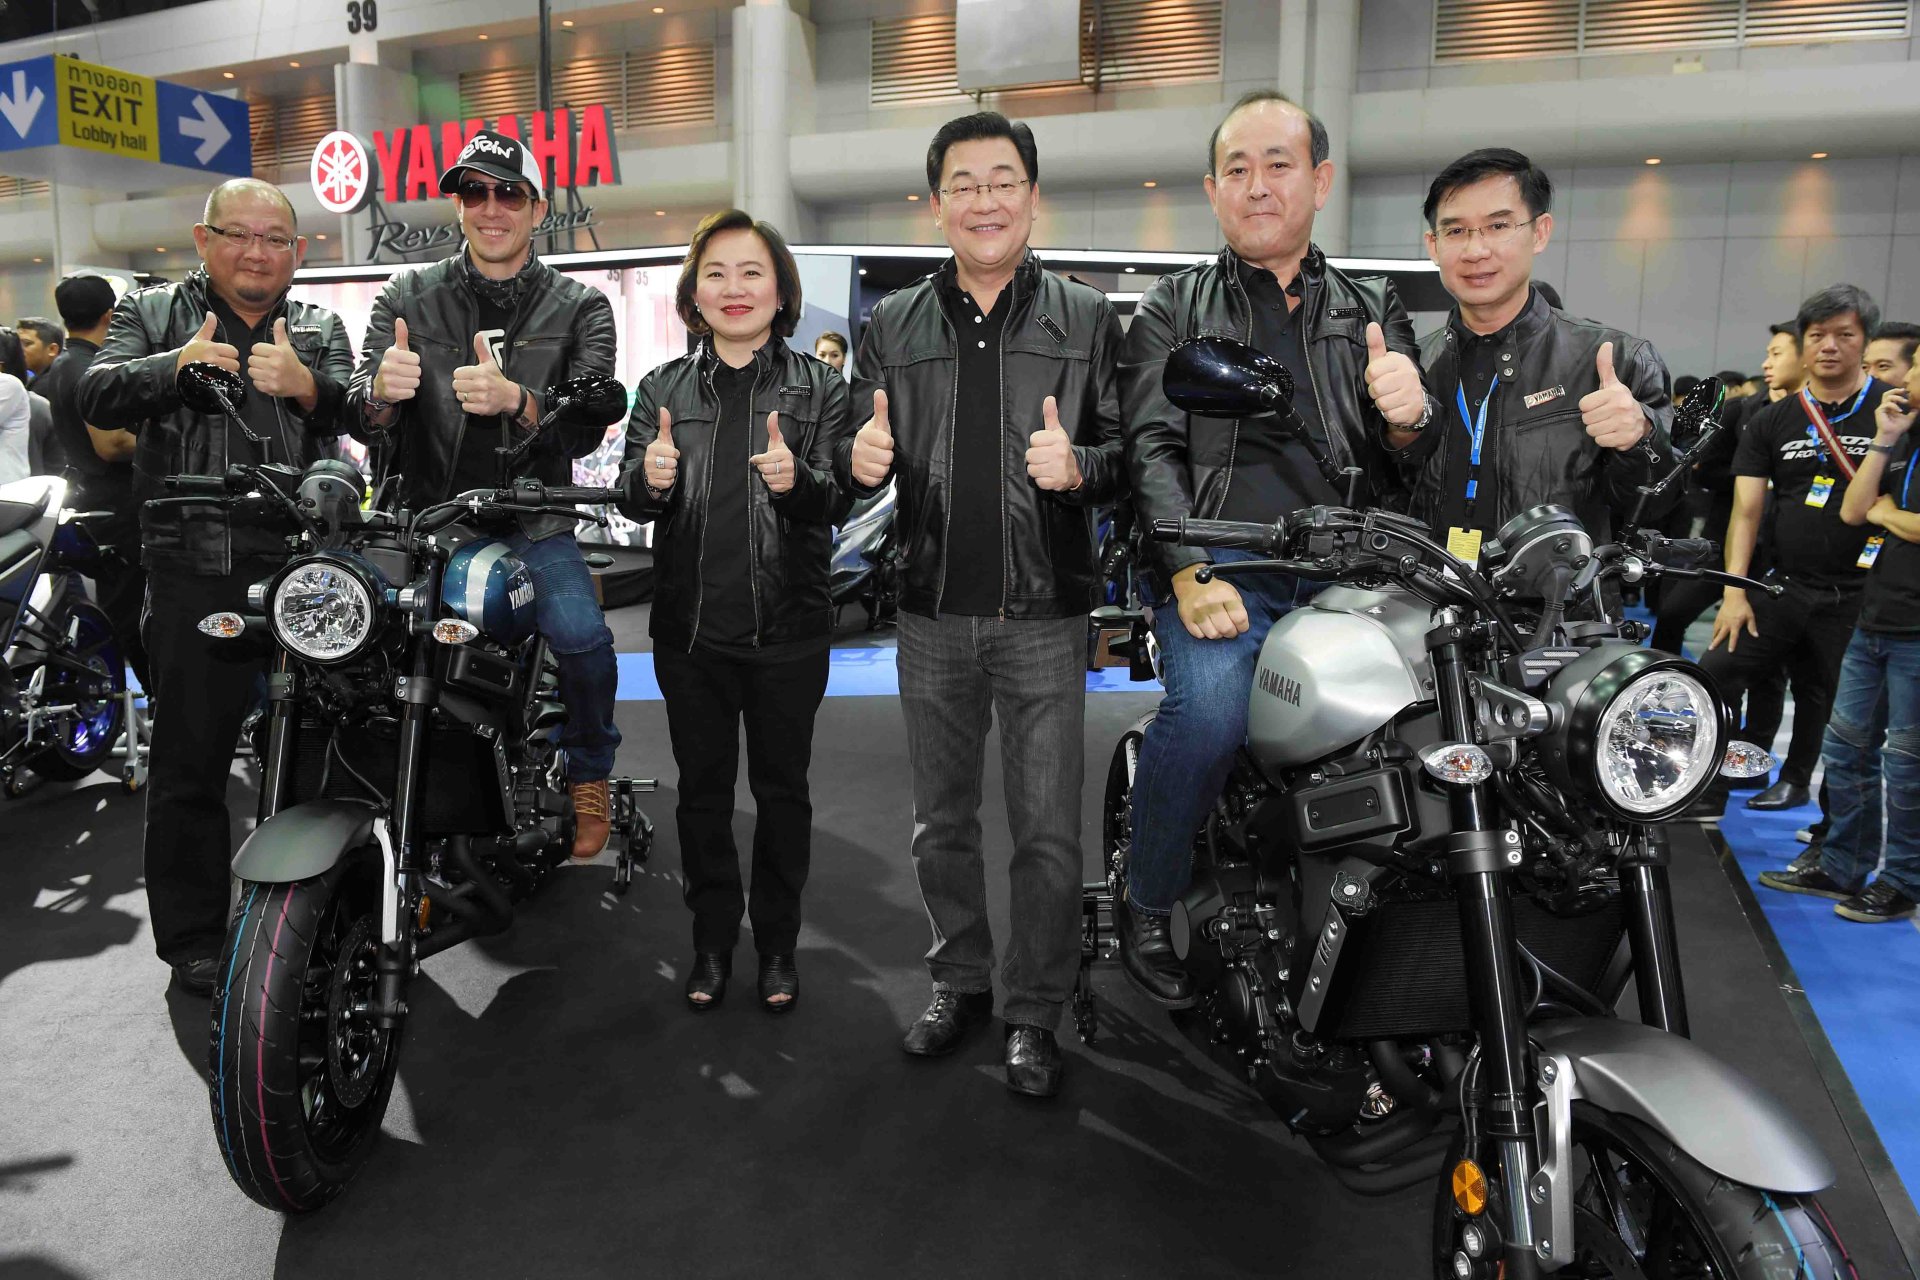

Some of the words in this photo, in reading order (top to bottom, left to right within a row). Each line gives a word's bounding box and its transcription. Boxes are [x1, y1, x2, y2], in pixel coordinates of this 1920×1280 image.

[347, 0, 377, 34] 39
[68, 65, 143, 96] ทางออก
[69, 85, 143, 126] EXIT
[72, 121, 117, 149] Lobby
[120, 131, 147, 151] hall
[1259, 666, 1301, 707] YAMAHA
